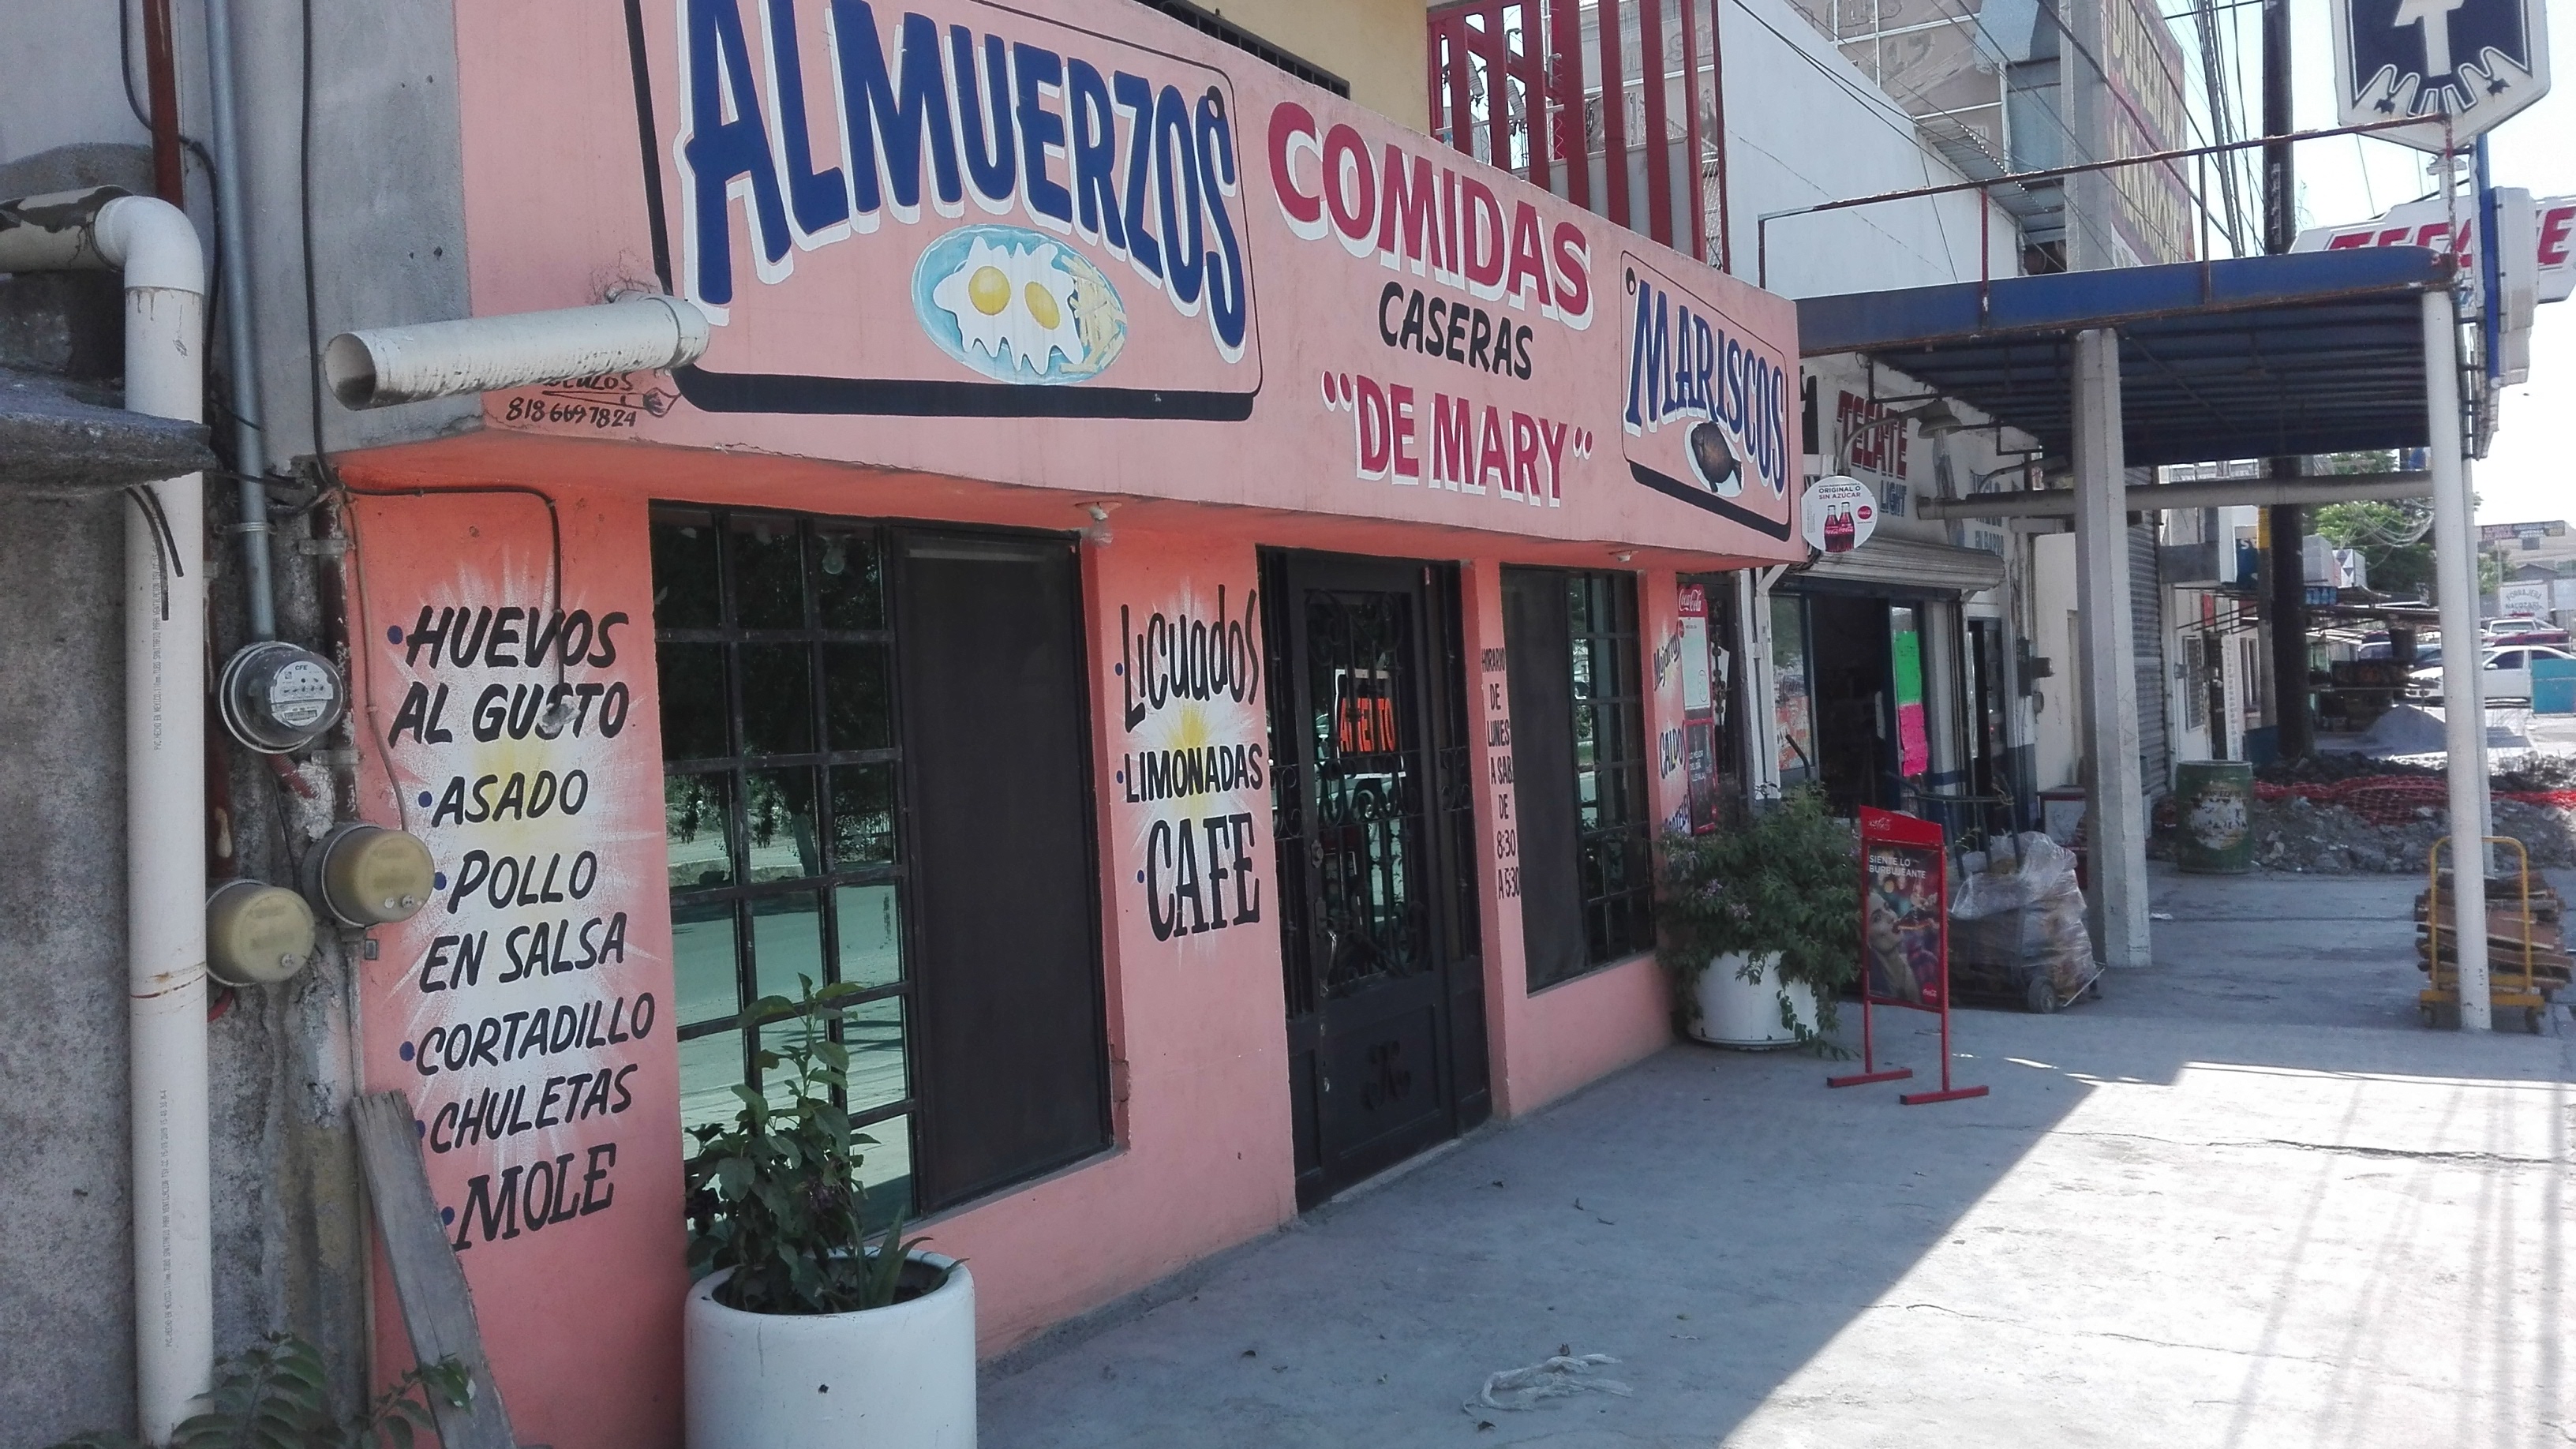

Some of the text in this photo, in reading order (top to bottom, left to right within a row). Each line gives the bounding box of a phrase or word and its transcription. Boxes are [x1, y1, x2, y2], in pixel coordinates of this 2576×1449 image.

[674, 0, 1247, 364] ALMUERZOS
[1267, 101, 1593, 330] COMIDAS
[1378, 280, 1533, 380] CASERAS
[1624, 279, 1785, 500] MARISCOS
[1837, 390, 1908, 481] TECATE
[1879, 480, 1908, 518] LIGHT
[1679, 588, 1702, 612] Coca-Cola
[405, 605, 629, 668] HUEVOS
[1481, 648, 1506, 672] HORARIO
[388, 681, 453, 748] AL
[1489, 683, 1501, 710] DE
[1487, 719, 1510, 747] LUNES
[431, 769, 589, 828] ASADO
[1125, 743, 1263, 803] LIMONADAS
[1491, 757, 1496, 784] A
[1499, 794, 1509, 819] DE
[1496, 829, 1516, 859] 8:30
[1869, 855, 1911, 867] SIENTE LO
[1869, 864, 1926, 878] BURBUJEANTE
[447, 849, 597, 914] POLLO
[1147, 813, 1260, 942] CAFE
[1498, 869, 1503, 900] A
[418, 912, 627, 994] EN SALSA
[415, 992, 655, 1076] CORTADILLO
[429, 1063, 638, 1153] CHULETAS
[452, 1142, 616, 1251] MOLE
